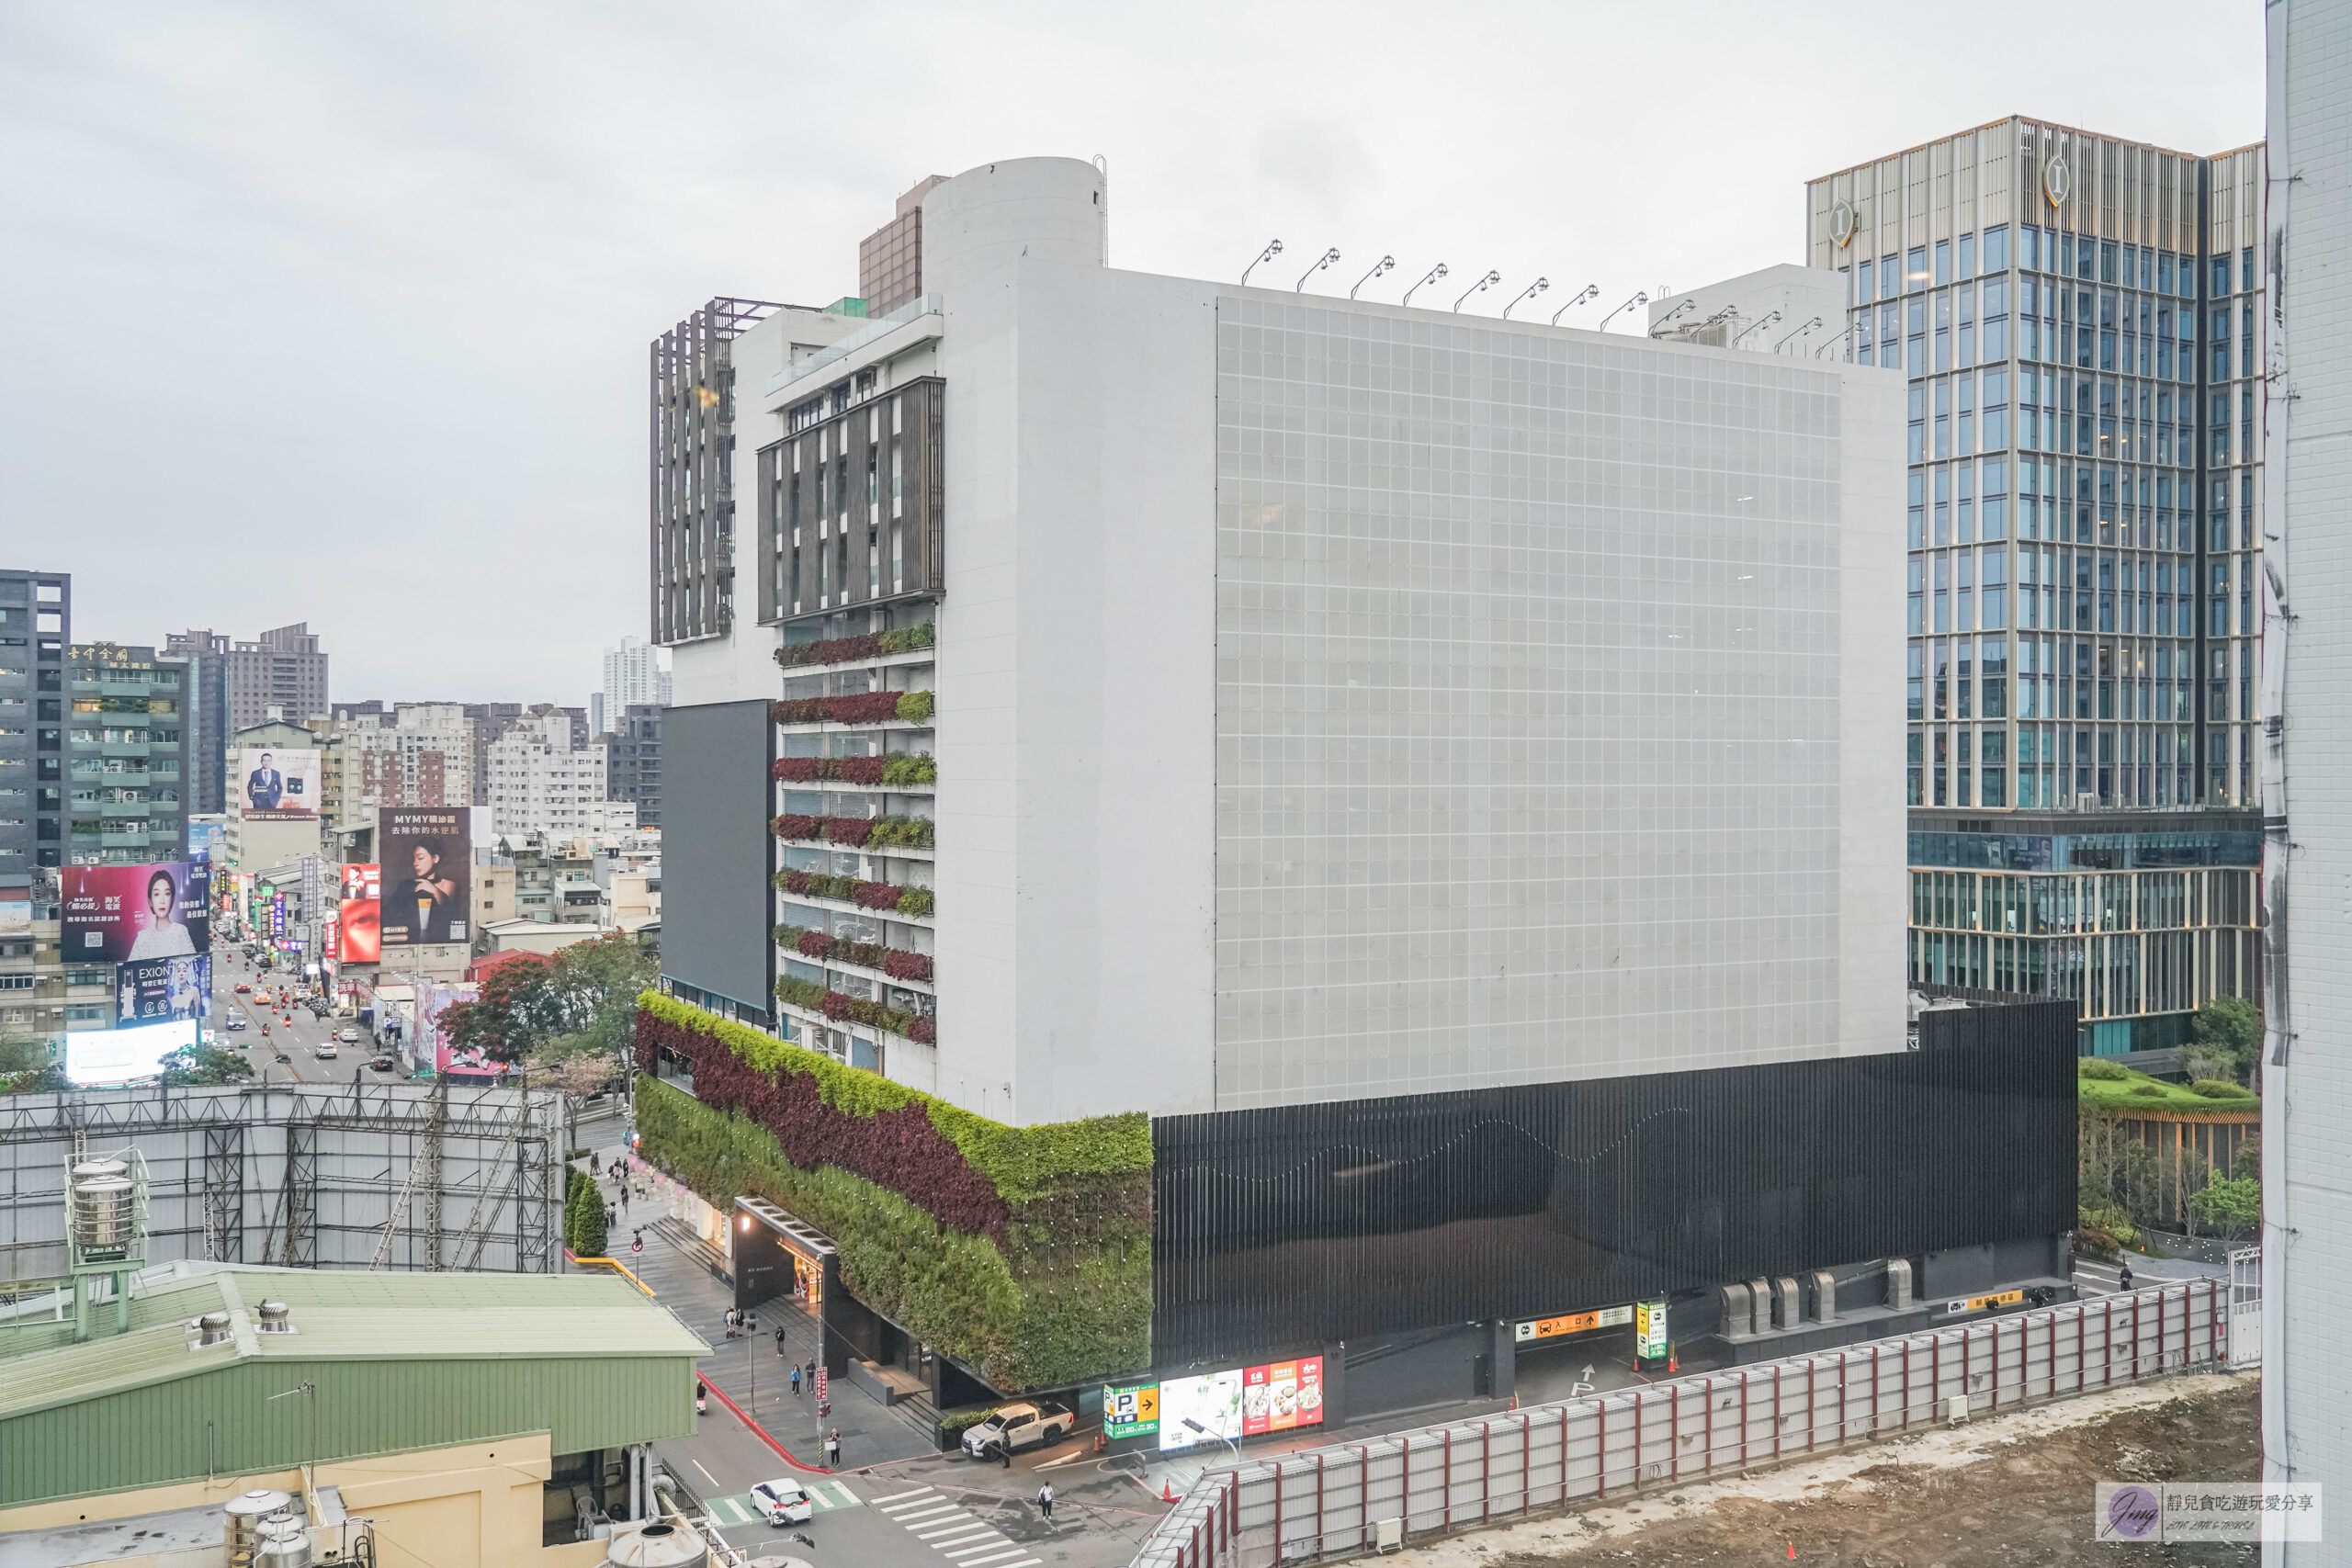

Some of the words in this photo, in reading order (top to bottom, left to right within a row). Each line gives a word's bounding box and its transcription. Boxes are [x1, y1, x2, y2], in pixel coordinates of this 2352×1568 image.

[392, 827, 459, 835] 去除你的水逆肌
[140, 966, 169, 979] EXION
[1571, 1382, 1595, 1396] P
[1118, 1394, 1133, 1412] P
